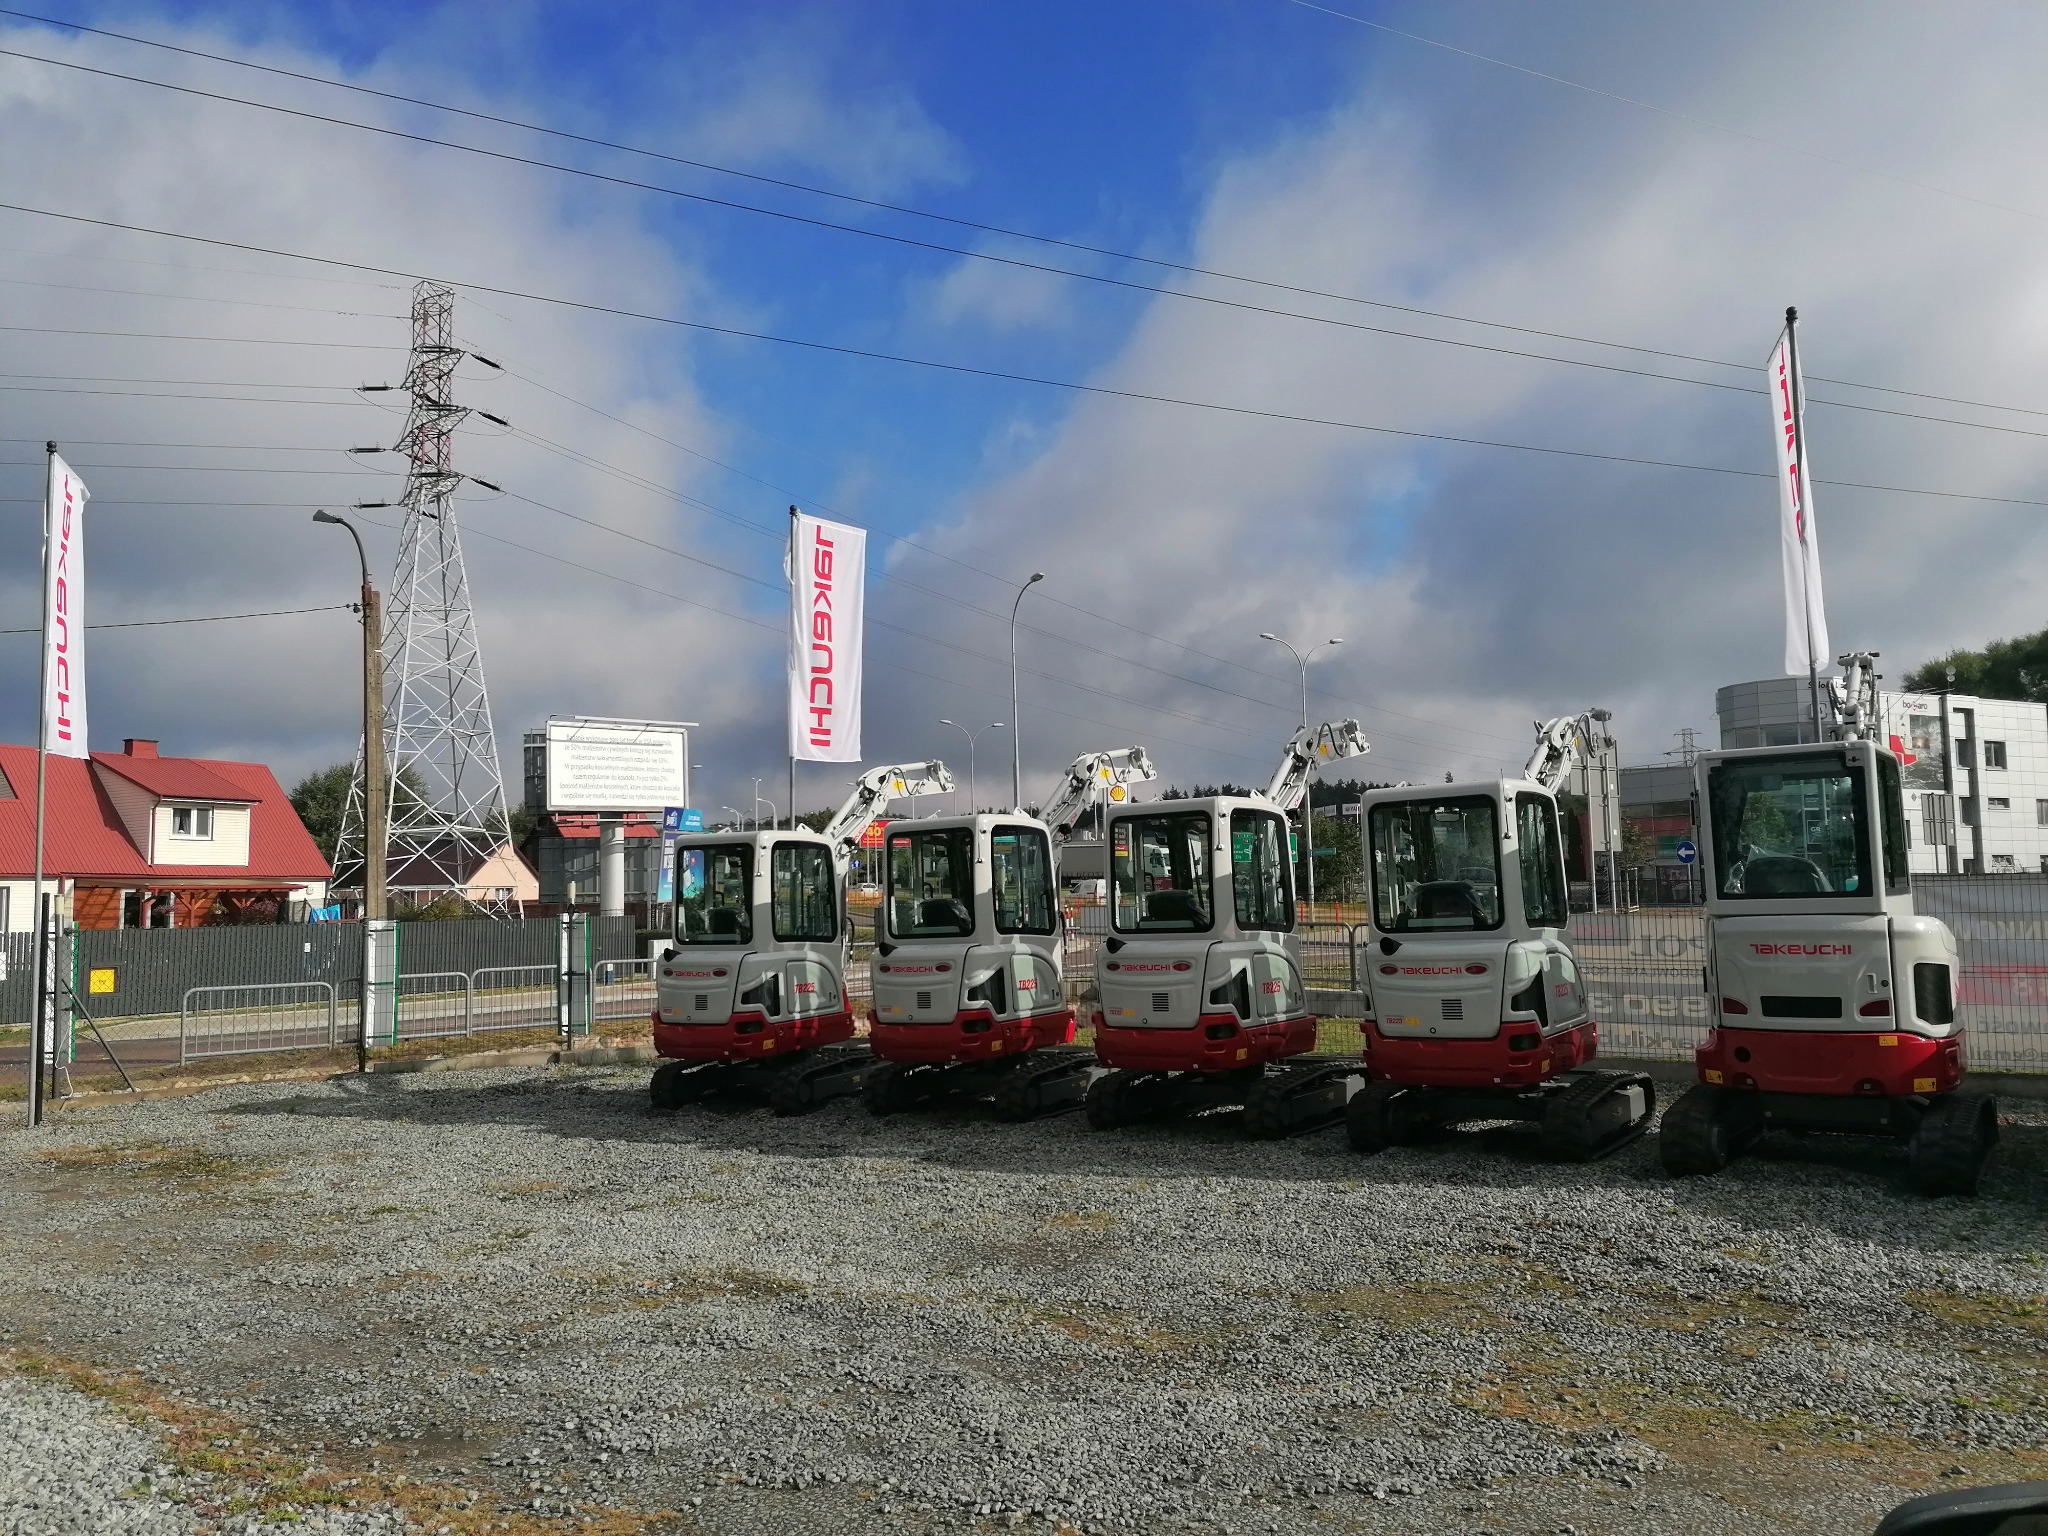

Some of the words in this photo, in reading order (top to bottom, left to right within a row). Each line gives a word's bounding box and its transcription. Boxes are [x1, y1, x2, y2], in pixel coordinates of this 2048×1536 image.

[1750, 944, 1852, 955] TAKEUCHI
[1121, 964, 1171, 972] TAKEUCHI
[1400, 967, 1462, 975] TAKEUCHI
[673, 970, 711, 978] TAKEUCHI
[795, 982, 815, 993] TB225
[1018, 978, 1038, 990] TB225
